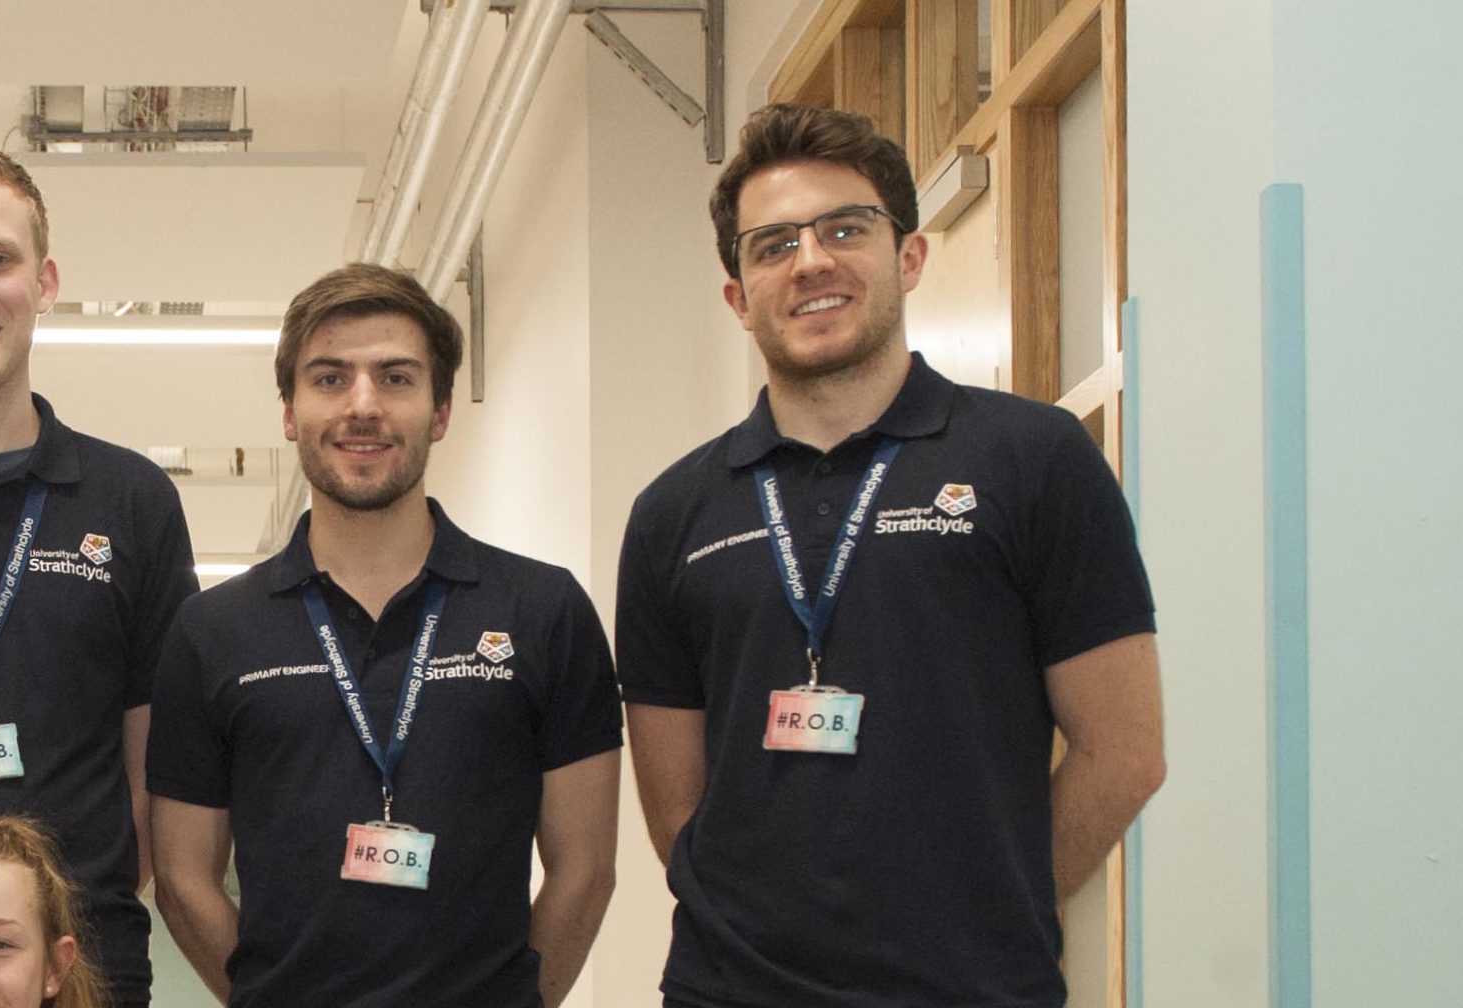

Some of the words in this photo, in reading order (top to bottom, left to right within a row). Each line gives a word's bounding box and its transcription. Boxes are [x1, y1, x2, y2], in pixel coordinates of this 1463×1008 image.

[850, 462, 886, 524] Strathclyde
[774, 525, 790, 537] of
[846, 523, 859, 536] of
[874, 515, 974, 535] Strathclyde
[8, 517, 34, 574] Strathclyde
[727, 528, 770, 546] ENGINEE
[29, 549, 70, 560] University
[29, 558, 111, 583] Strathclyde
[778, 536, 806, 600] Strathclyde
[823, 537, 856, 597] University
[5, 573, 16, 588] of
[412, 613, 439, 667] University
[319, 624, 348, 679] Strathclyde
[429, 653, 466, 665] niversity
[466, 652, 477, 661] of
[239, 666, 282, 685] PRIMARY
[412, 667, 424, 678] of
[338, 678, 354, 691] of
[346, 691, 374, 744] University
[396, 678, 422, 741] Strathclyde
[777, 712, 849, 732] #R.O.B.
[354, 845, 422, 868] #R.O.B.
